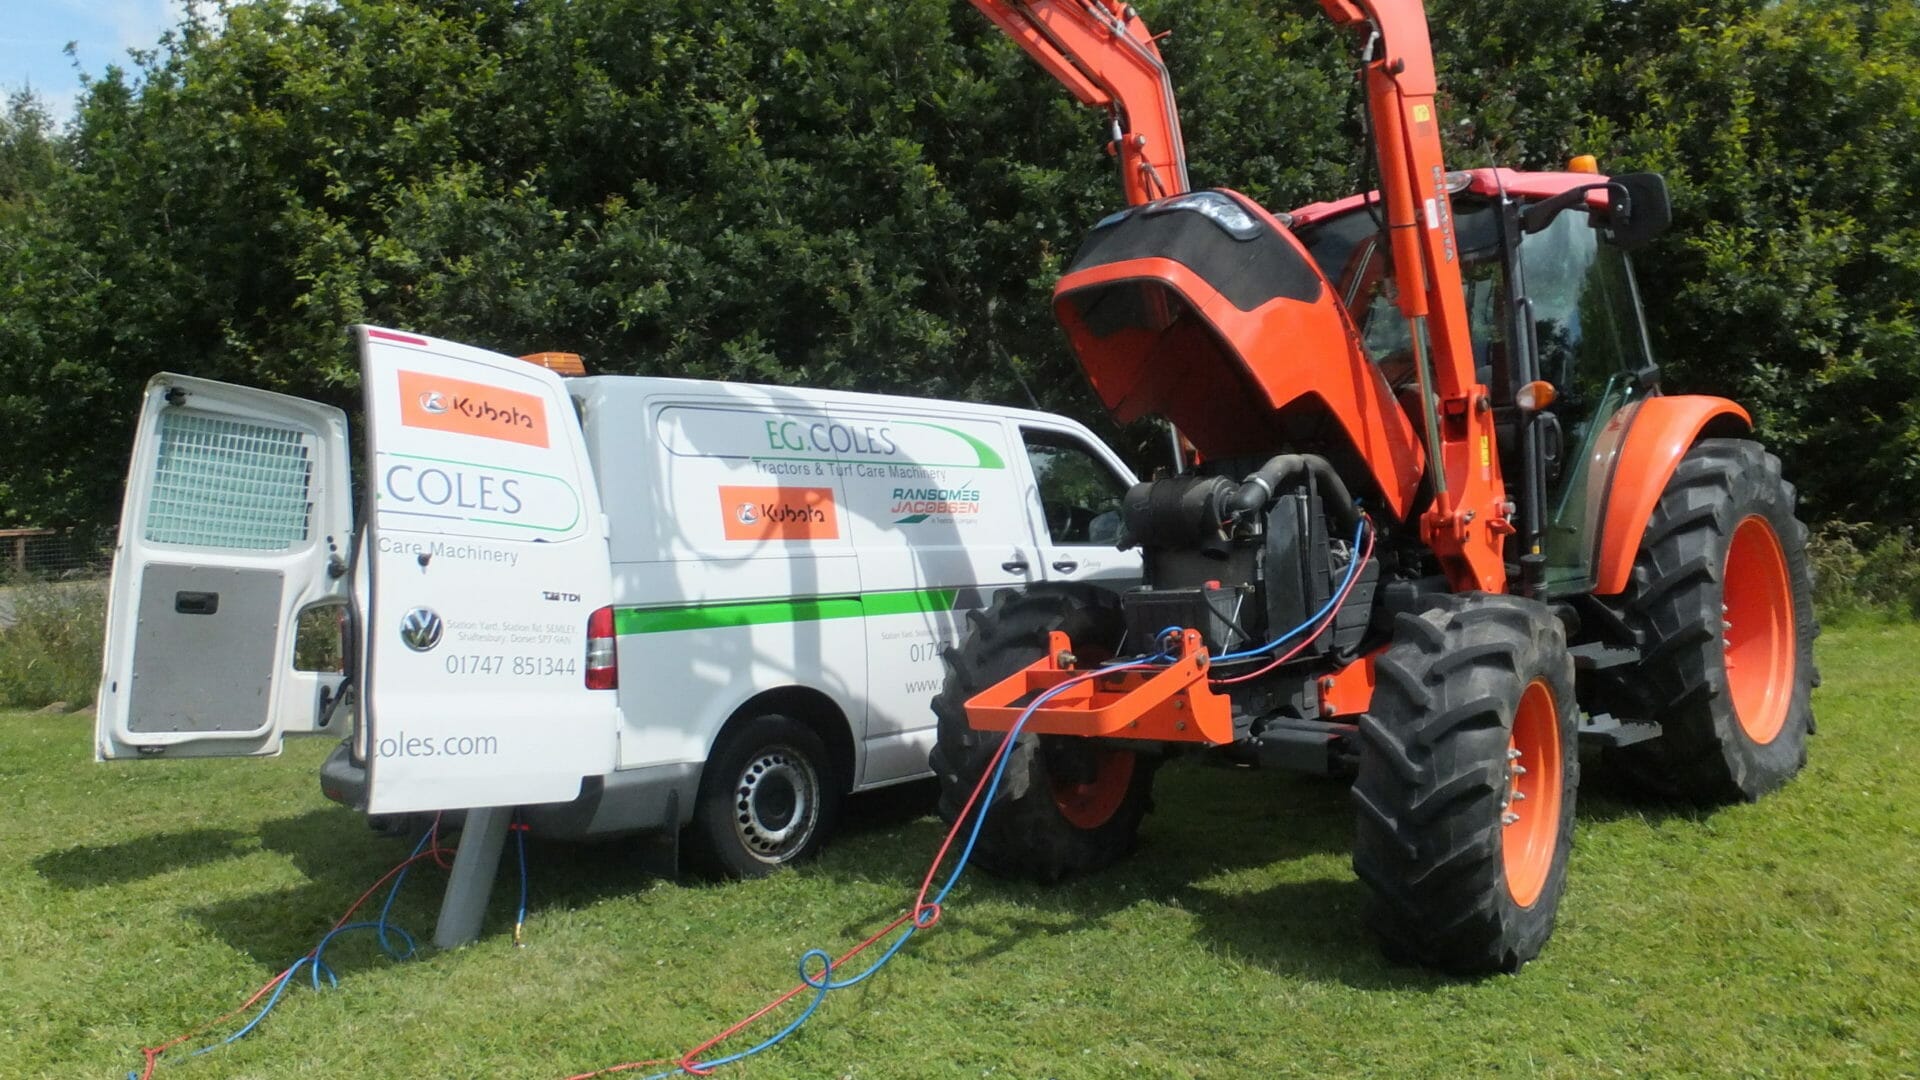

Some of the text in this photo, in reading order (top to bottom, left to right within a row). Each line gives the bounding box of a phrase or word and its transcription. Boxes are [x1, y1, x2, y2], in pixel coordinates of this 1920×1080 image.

[453, 396, 533, 428] Kubota
[753, 460, 946, 482] Tractors & Turf Care Machinery
[892, 488, 980, 501] RANSOMES
[761, 503, 825, 523] Kubota
[891, 501, 979, 514] JACOBSEN
[378, 537, 518, 567] Care Machinery
[446, 654, 576, 675] 01747 851344
[375, 731, 498, 758] oles.com
